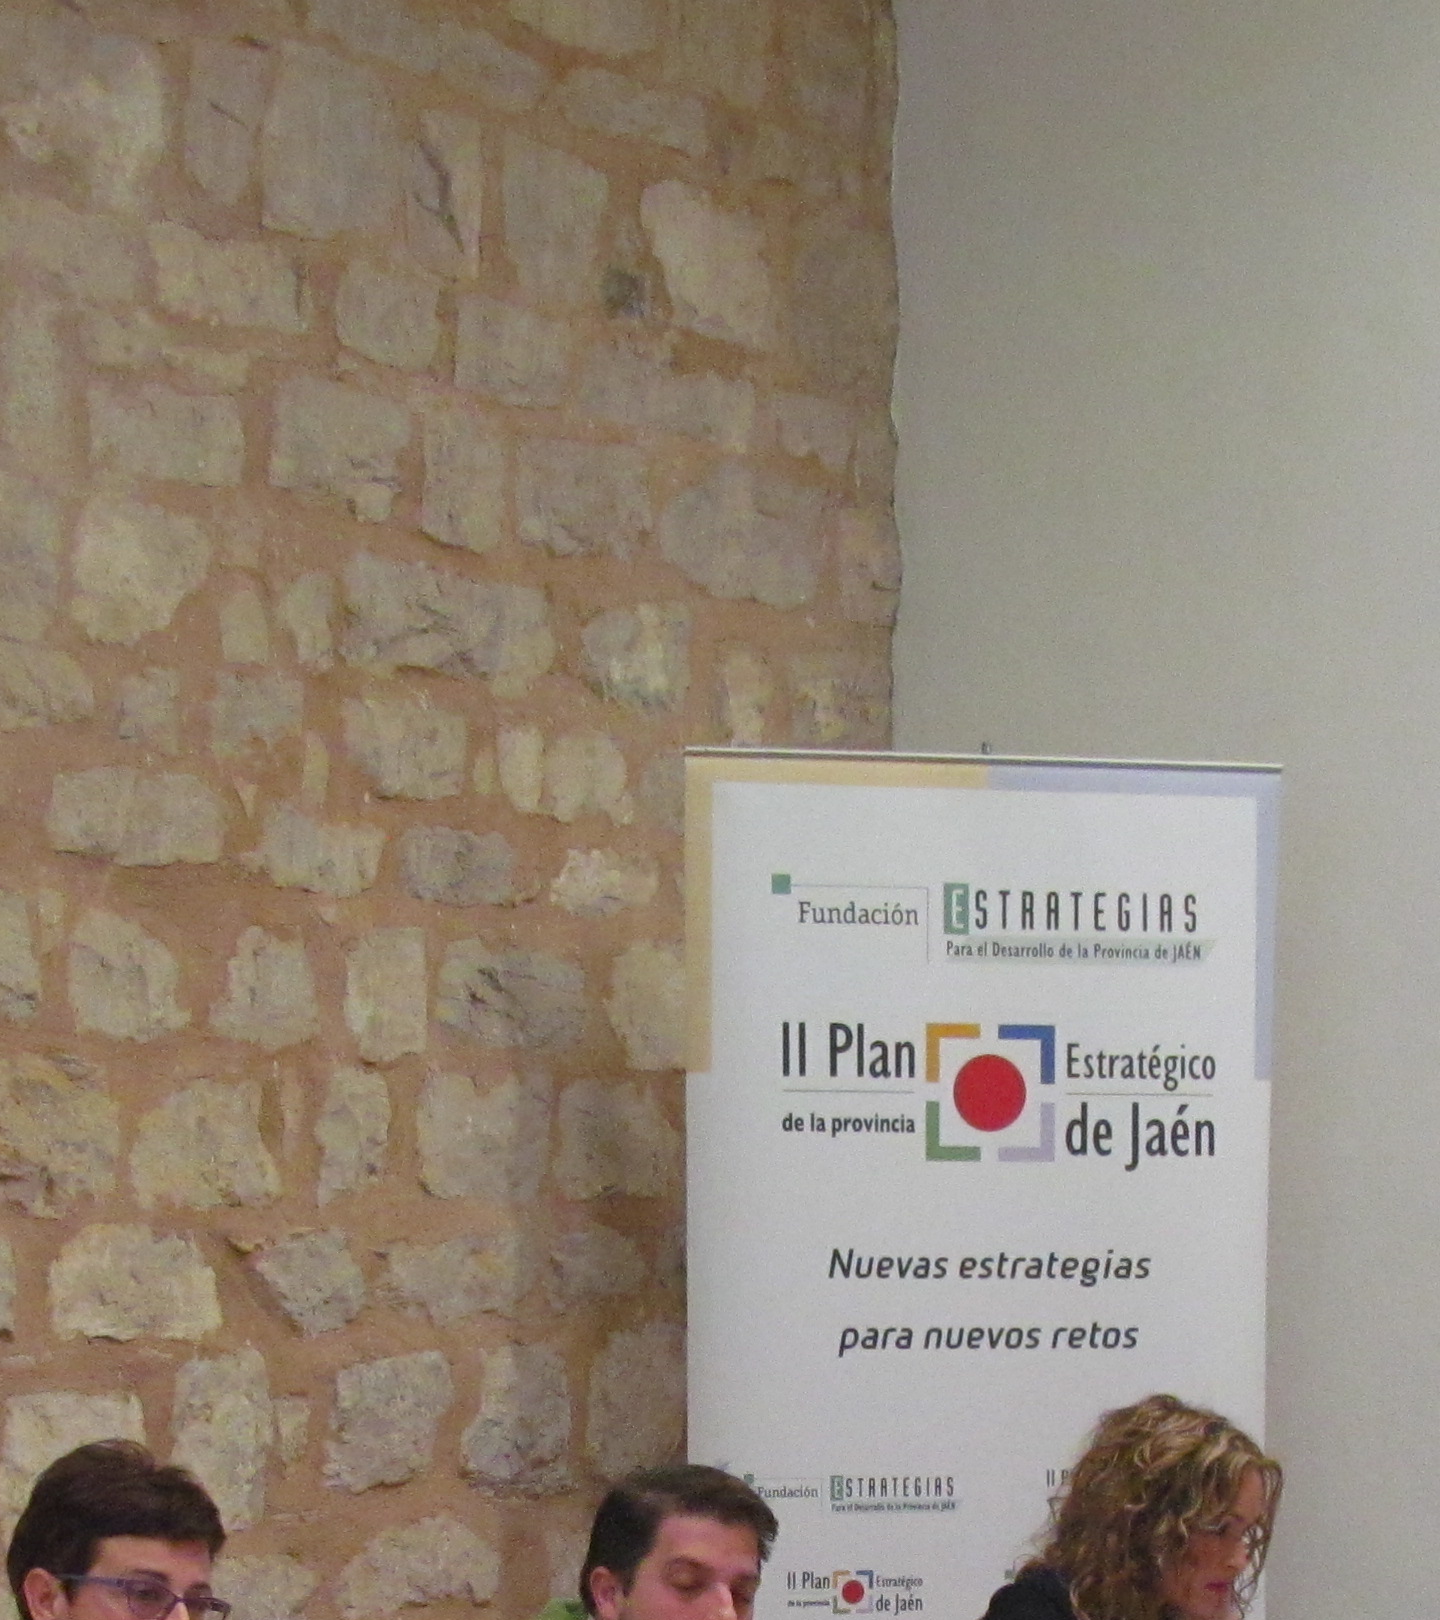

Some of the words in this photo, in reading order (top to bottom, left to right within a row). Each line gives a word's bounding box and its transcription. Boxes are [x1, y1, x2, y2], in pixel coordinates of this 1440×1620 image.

[798, 900, 919, 926] Fundación
[944, 882, 1198, 935] ESTRATEGIAS
[946, 941, 973, 958] Para
[978, 942, 987, 957] el
[992, 942, 1054, 959] Desarrollo
[1060, 943, 1073, 958] de
[1078, 943, 1088, 959] la
[1094, 943, 1150, 961] Provincia
[1155, 944, 1168, 960] de
[1173, 941, 1202, 963] JAÉN
[782, 1021, 807, 1078] II
[829, 1022, 916, 1079] Plan
[1066, 1042, 1216, 1092] Estratégico
[782, 1113, 805, 1132] de
[809, 1112, 826, 1133] la
[831, 1112, 916, 1138] provincia
[1065, 1102, 1113, 1157] de
[1124, 1101, 1216, 1172] Jaén
[828, 1247, 949, 1280] Nuevas
[959, 1249, 1152, 1287] estrategias
[838, 1326, 913, 1359] para
[923, 1326, 1042, 1350] nuevos
[1051, 1320, 1140, 1350] retos
[829, 1475, 955, 1501] ESTRATEGIAS
[802, 1571, 831, 1590] Plan
[876, 1574, 923, 1590] Estratégico
[876, 1594, 891, 1612] de
[894, 1593, 923, 1616] Jaén
